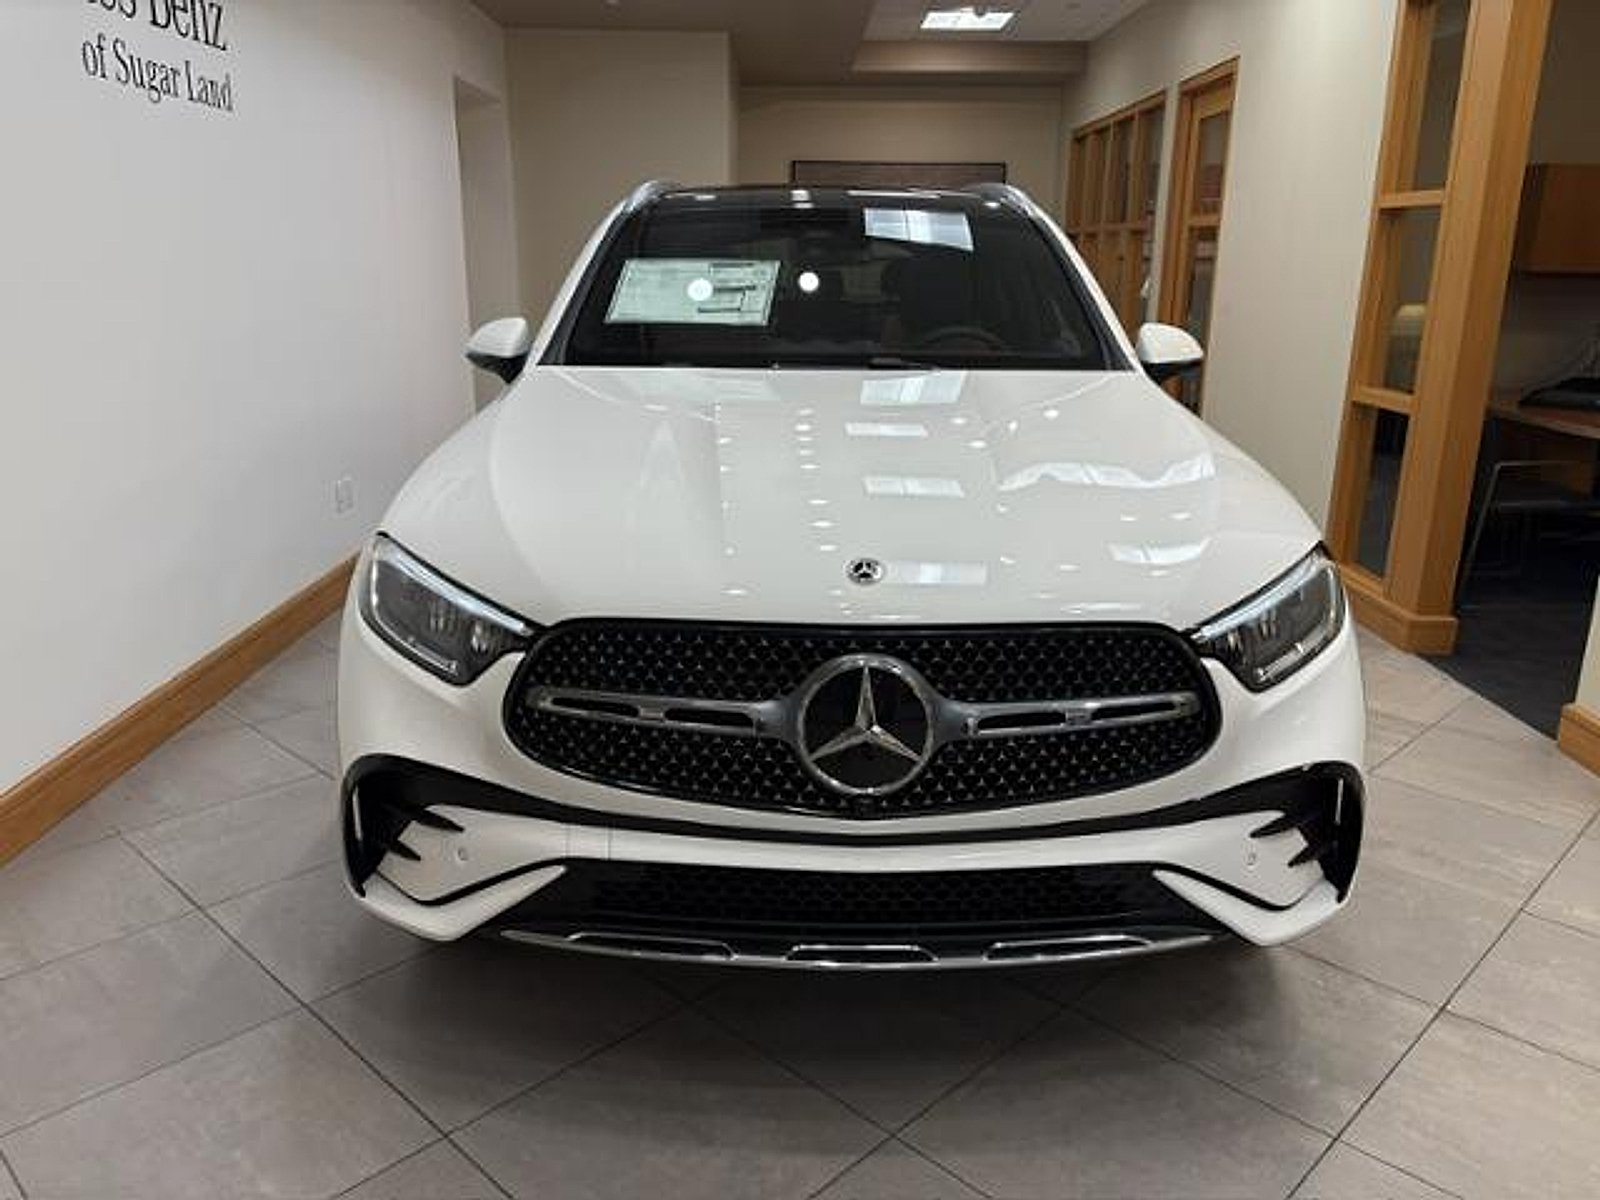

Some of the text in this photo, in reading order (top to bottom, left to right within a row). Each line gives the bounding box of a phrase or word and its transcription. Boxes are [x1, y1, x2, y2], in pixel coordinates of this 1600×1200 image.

[82, 32, 233, 111] of Sugar Land
